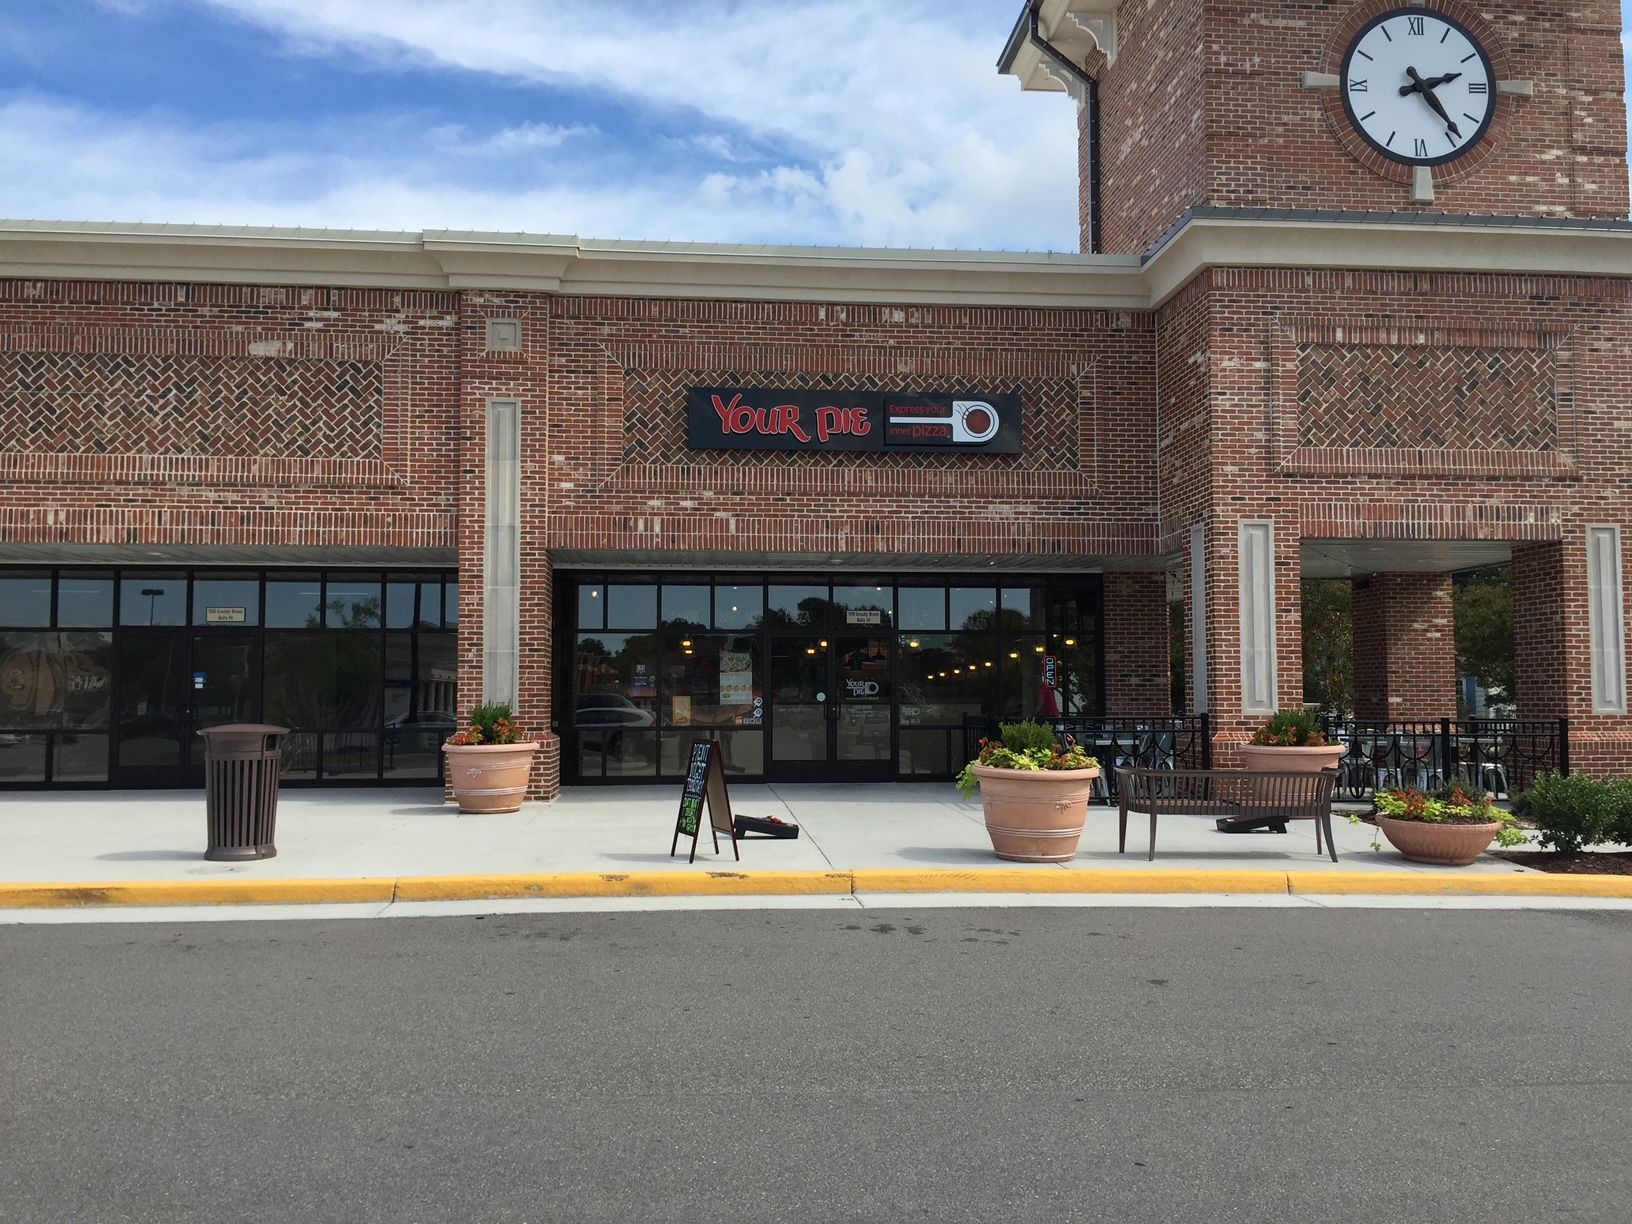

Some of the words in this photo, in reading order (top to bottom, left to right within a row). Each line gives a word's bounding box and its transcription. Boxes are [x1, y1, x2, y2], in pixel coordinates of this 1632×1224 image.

[1407, 17, 1424, 35] XII
[889, 404, 922, 415] Express
[924, 405, 946, 415] your
[889, 426, 911, 435] inner
[912, 425, 947, 438] pizza
[1045, 656, 1056, 687] OPEN
